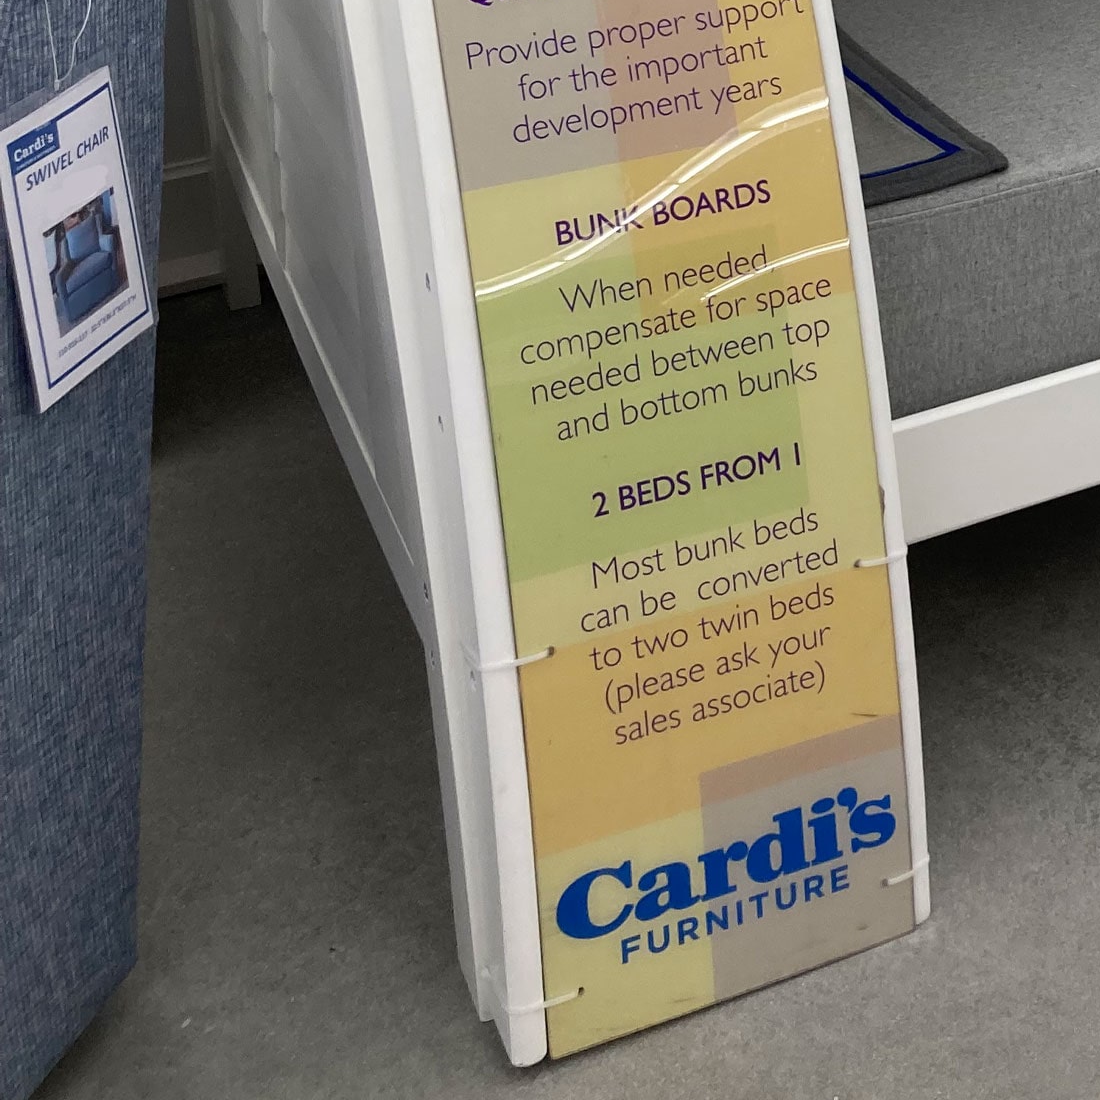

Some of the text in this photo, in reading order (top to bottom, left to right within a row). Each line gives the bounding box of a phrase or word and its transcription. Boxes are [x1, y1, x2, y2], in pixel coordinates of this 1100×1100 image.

[465, 28, 577, 70] Provide
[588, 14, 686, 57] proper
[517, 36, 769, 101] for the important
[13, 132, 54, 163] Cardi's
[512, 75, 783, 144] development years
[26, 150, 74, 192] SWIVEL
[76, 125, 110, 160] CHAIR
[555, 179, 772, 246] BUNK BOARDS
[520, 279, 832, 365] compensate for space
[558, 278, 653, 313] When
[531, 318, 830, 406] needed between top
[557, 358, 818, 441] and bottom bunks
[591, 490, 610, 518] 2
[617, 470, 692, 512] BEDS
[700, 447, 782, 491] FROM
[580, 538, 839, 633] can be converted
[591, 507, 819, 589] Most bunk beds
[588, 582, 835, 672] to two twin beds
[604, 626, 831, 715] (please ask your
[614, 660, 827, 746] sales associate)
[555, 786, 897, 940] Cardi's
[620, 864, 851, 965] FURNITURE
